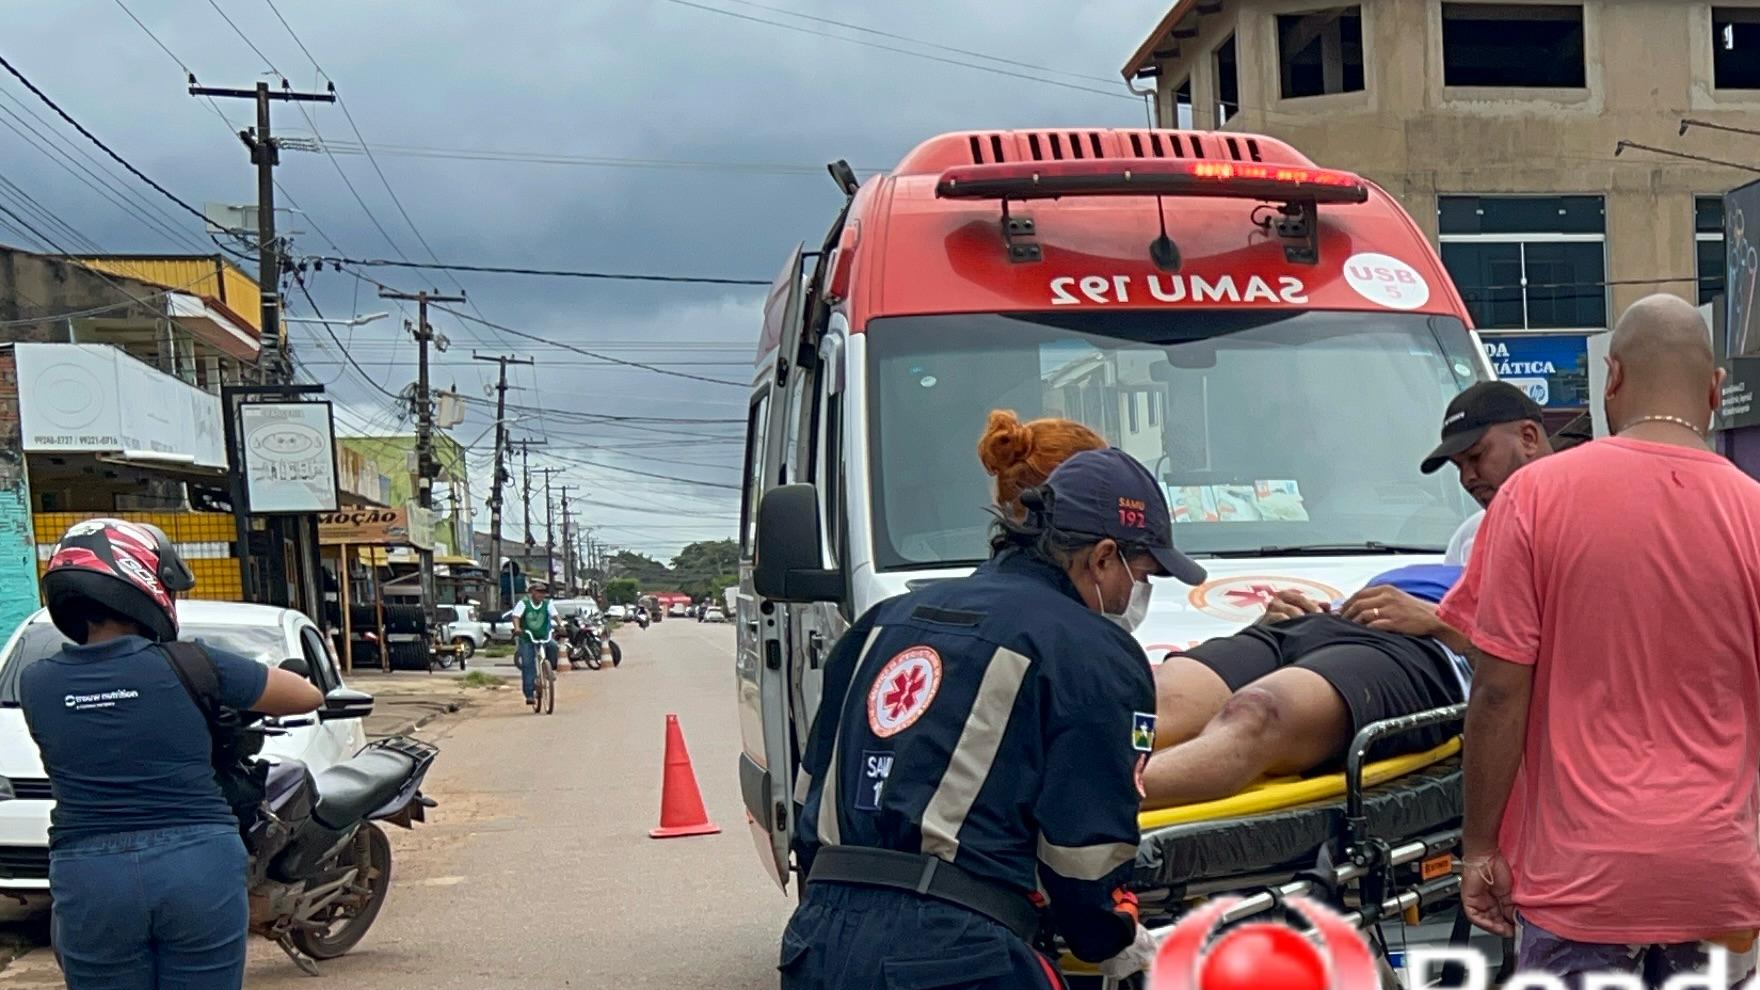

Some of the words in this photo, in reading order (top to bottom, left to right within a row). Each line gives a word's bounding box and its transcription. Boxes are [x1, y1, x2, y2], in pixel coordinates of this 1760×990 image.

[1349, 265, 1417, 284] USB
[1385, 285, 1401, 299] 5
[1118, 509, 1146, 528] 192
